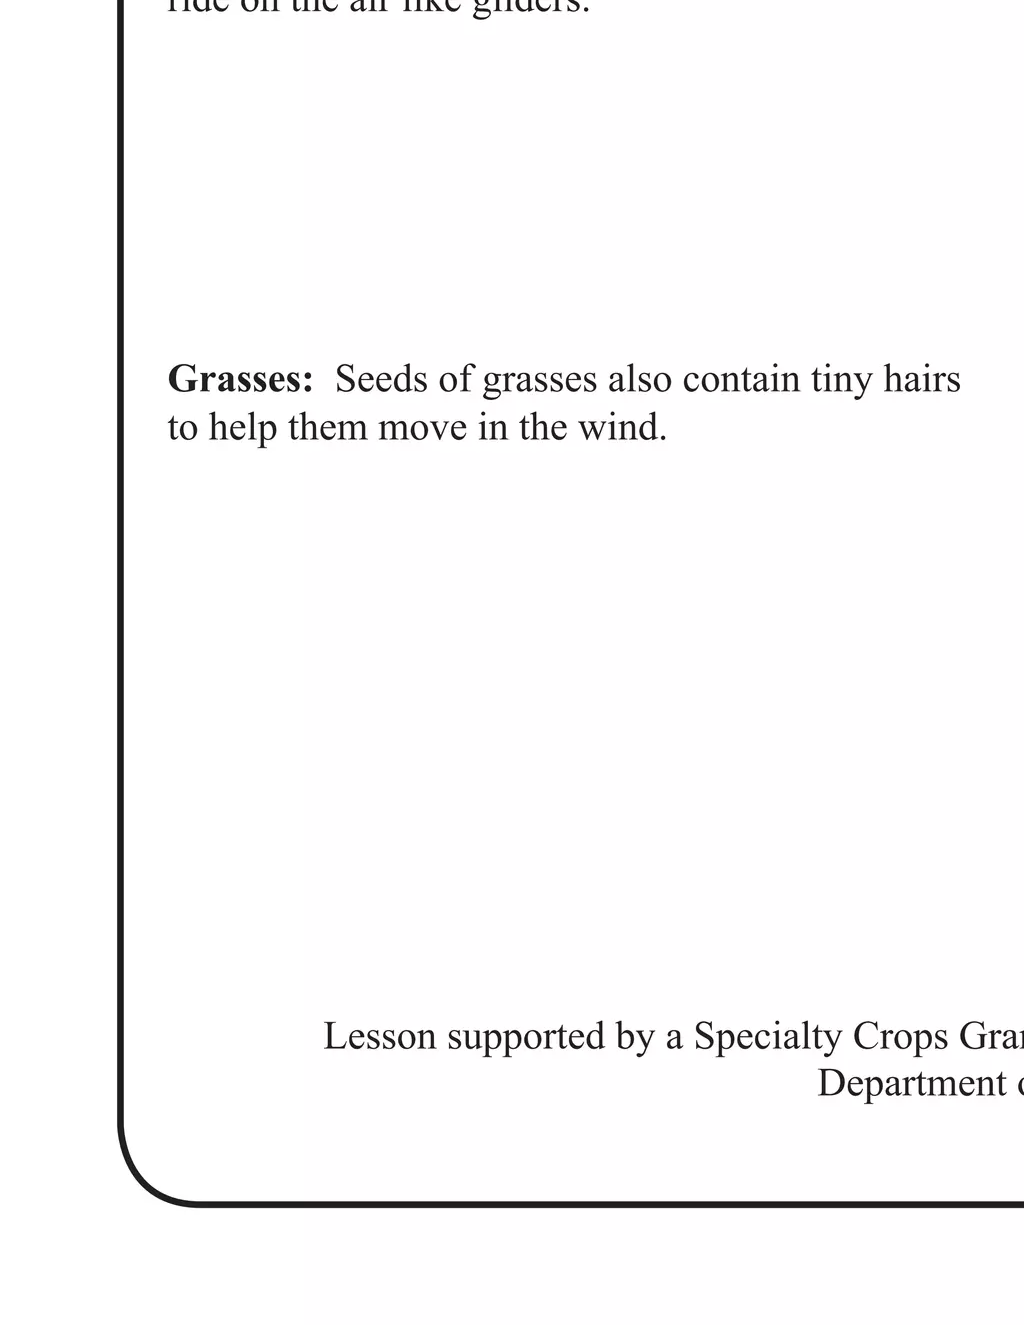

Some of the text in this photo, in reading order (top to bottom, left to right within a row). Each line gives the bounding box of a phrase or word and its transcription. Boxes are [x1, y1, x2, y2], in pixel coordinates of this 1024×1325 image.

[168, 362, 961, 401] Grasses: Seeds of grasses also contain tiny hairs
[167, 410, 666, 449] to help them move in the wind.
[323, 1021, 437, 1050] Lesson
[448, 1020, 606, 1058] supported
[615, 1020, 656, 1058] by
[666, 1029, 684, 1050] a
[695, 1020, 843, 1058] Specialty
[853, 1020, 949, 1058] Crops
[817, 1068, 1008, 1105] Department
